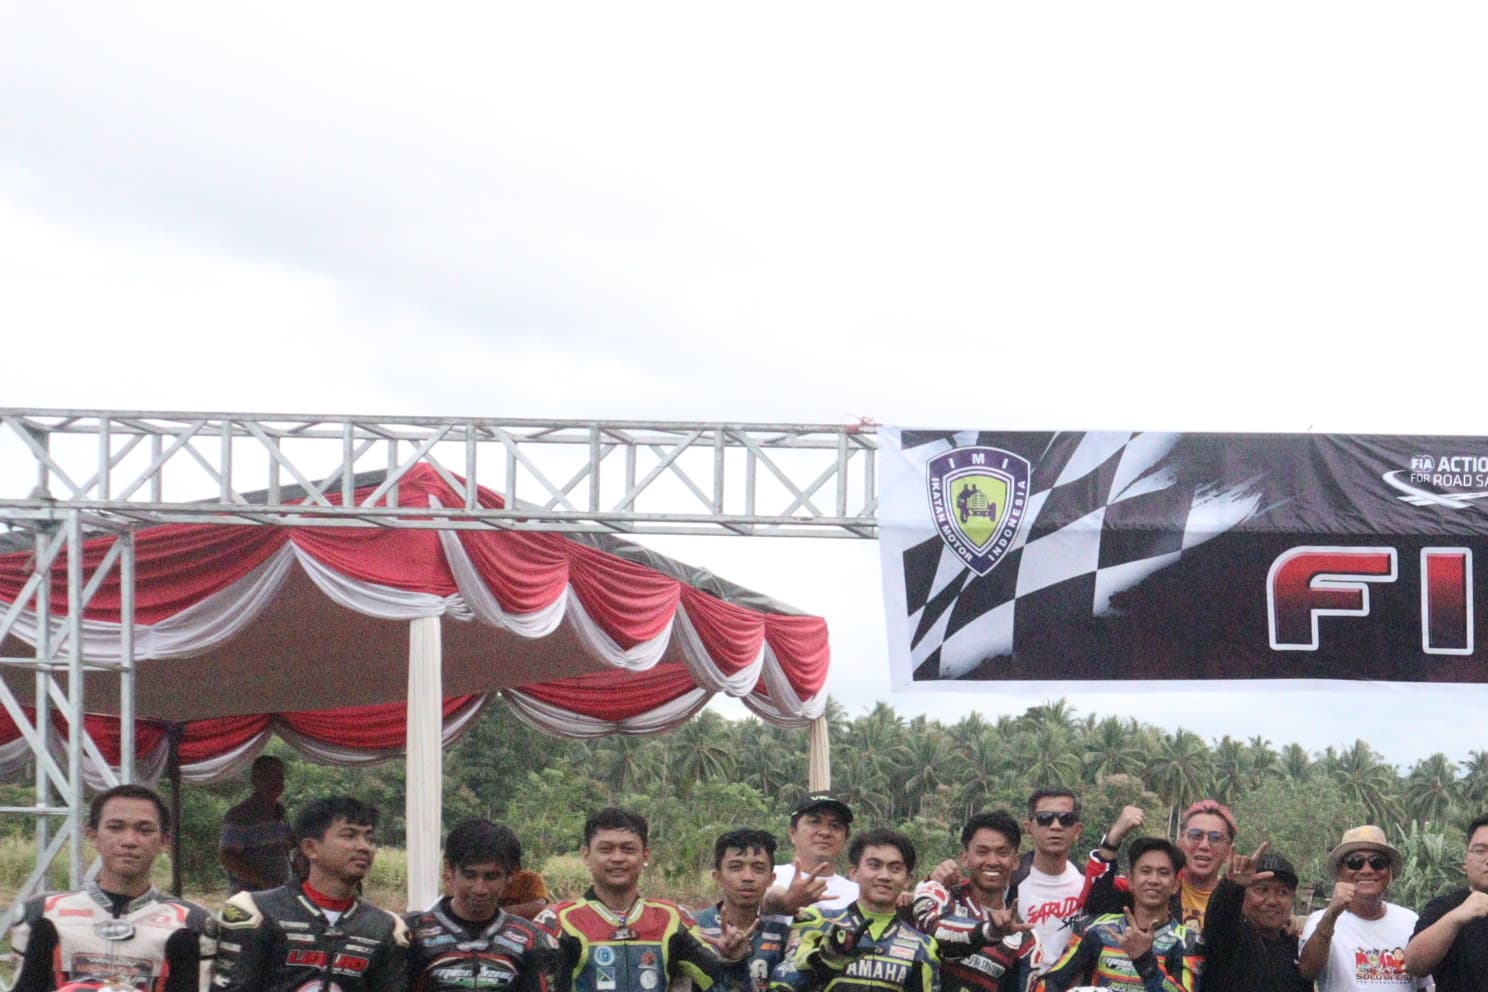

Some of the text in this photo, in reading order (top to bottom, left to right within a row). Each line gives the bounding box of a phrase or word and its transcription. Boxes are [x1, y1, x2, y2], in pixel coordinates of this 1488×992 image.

[949, 453, 1008, 469] IMI
[1410, 473, 1430, 484] FOR
[1433, 474, 1474, 487] ROAD
[932, 477, 1027, 562] IKATAN MOTOR INDONESIA
[847, 961, 907, 983] AMAHA
